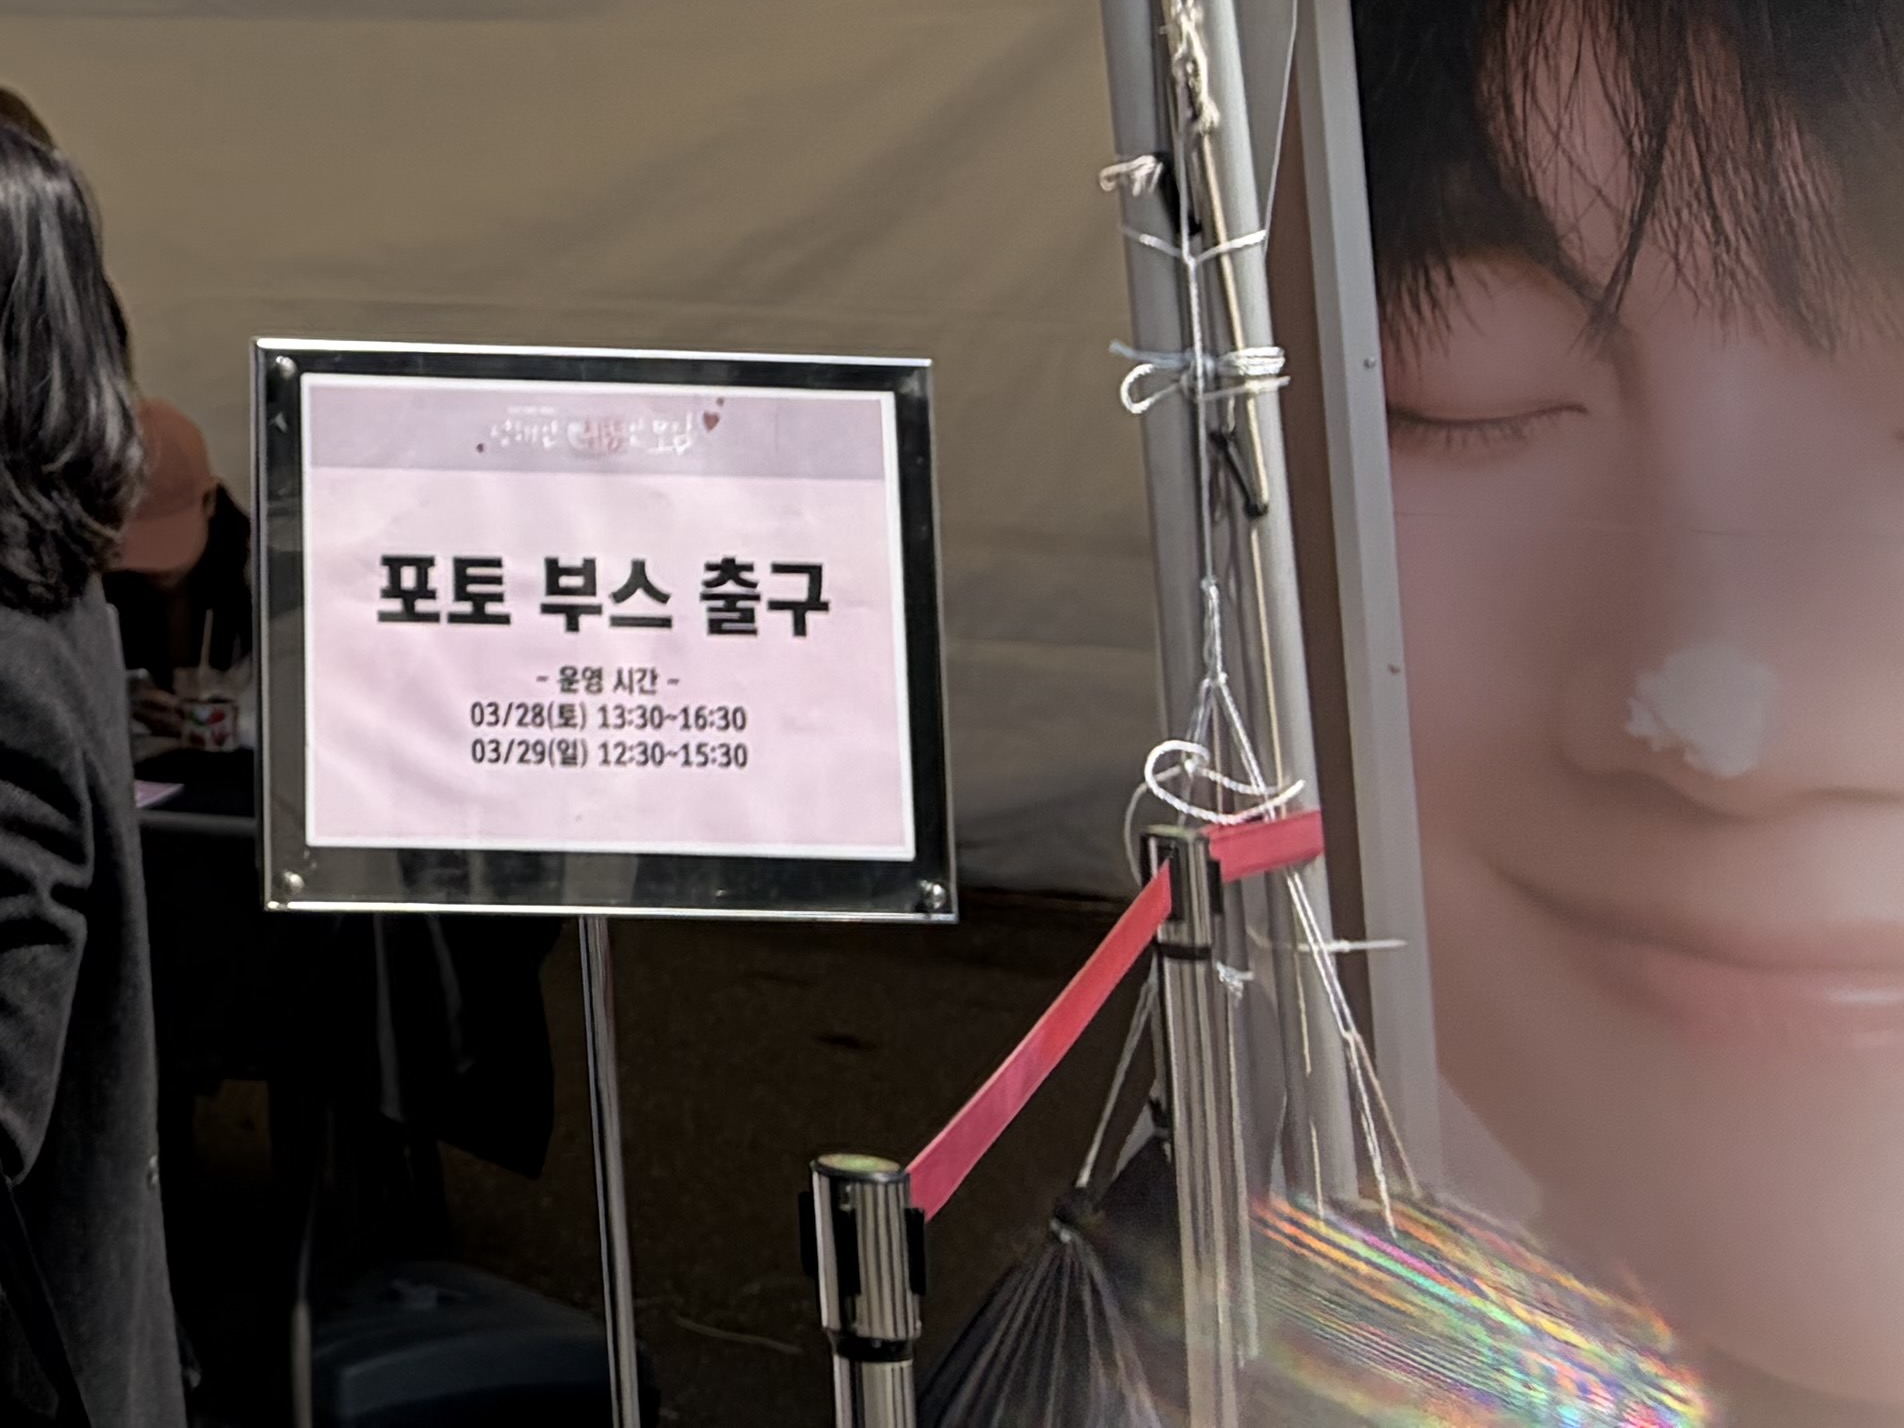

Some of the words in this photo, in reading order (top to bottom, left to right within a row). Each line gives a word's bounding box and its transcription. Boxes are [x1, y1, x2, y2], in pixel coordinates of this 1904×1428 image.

[377, 554, 511, 625] 포토
[540, 557, 672, 632] 부스
[700, 557, 830, 637] 출구
[558, 665, 603, 695] 운영
[614, 666, 659, 696] 시간
[470, 700, 587, 732] 03/28(토)
[597, 704, 748, 732] 13:30~16:30
[471, 737, 588, 768] 03/29(일)
[599, 741, 749, 769] 12:30~15:30
